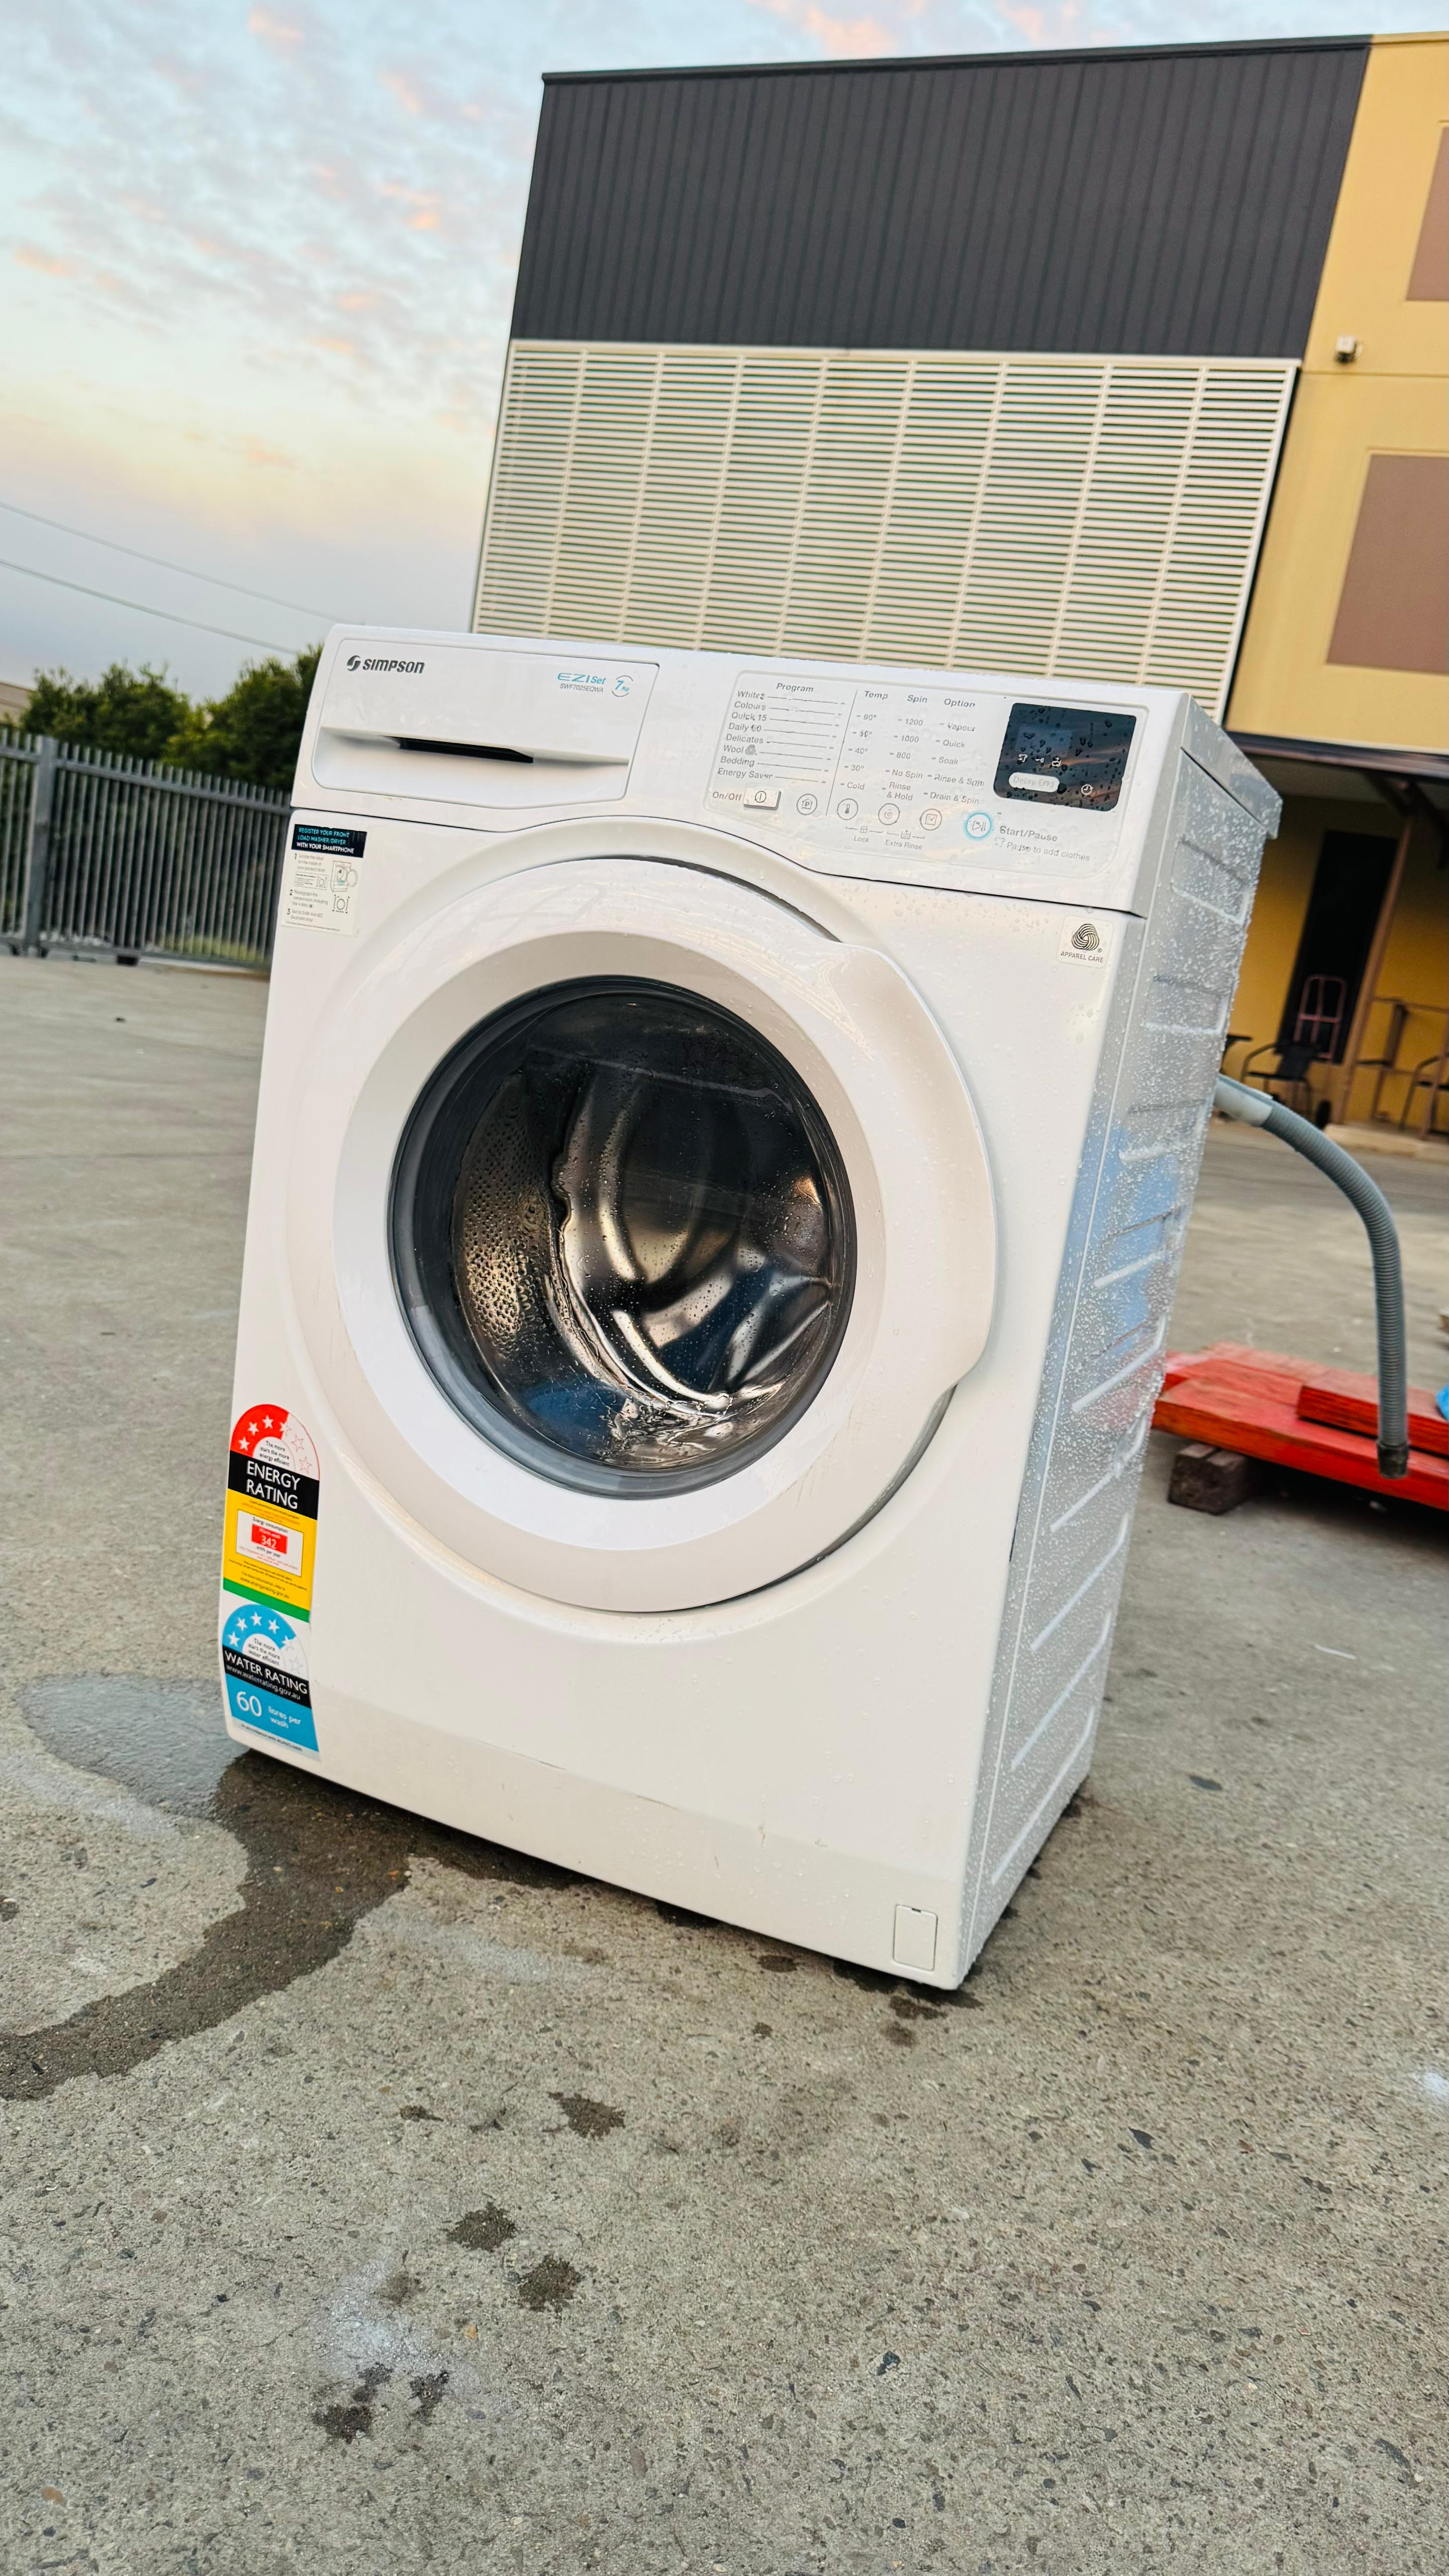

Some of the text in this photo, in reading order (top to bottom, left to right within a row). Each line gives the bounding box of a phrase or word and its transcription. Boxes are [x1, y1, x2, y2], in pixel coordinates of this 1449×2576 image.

[362, 659, 425, 674] SIMPSON
[560, 683, 604, 693] SWF7025EQWA
[615, 680, 624, 690] 7
[776, 683, 814, 692] Program
[738, 691, 765, 700] Whites
[864, 690, 888, 700] Temp
[907, 695, 928, 703] Spin
[734, 701, 766, 710] Colours
[944, 698, 975, 707] Option
[732, 712, 755, 721] Quick
[729, 723, 749, 733] Daily
[726, 734, 764, 744] Delicates
[943, 740, 965, 748] Quick
[723, 745, 744, 753] Wool
[720, 756, 755, 767] Bedding
[939, 757, 958, 765] Soak
[717, 768, 747, 779] Energy
[905, 771, 922, 779] Spin
[934, 774, 956, 783] Rinse
[1013, 776, 1035, 786] Delay
[847, 782, 865, 790] Cold
[889, 782, 911, 790] Rinse
[712, 791, 742, 801] On/Off
[895, 793, 913, 801] Hold
[930, 792, 951, 800] Drain
[961, 796, 979, 804] Spin
[1000, 826, 1058, 842] Start/Pause
[322, 845, 354, 854] SMARTPHONE
[1007, 842, 1031, 852] Pause
[1061, 851, 1090, 861] clothes
[1061, 951, 1086, 960] APPAREL
[247, 1460, 300, 1490] ENERGY
[246, 1479, 298, 1509] RATING
[225, 1650, 307, 1695] WATER RATING
[236, 1691, 262, 1717] 60
[288, 1716, 301, 1725] per
